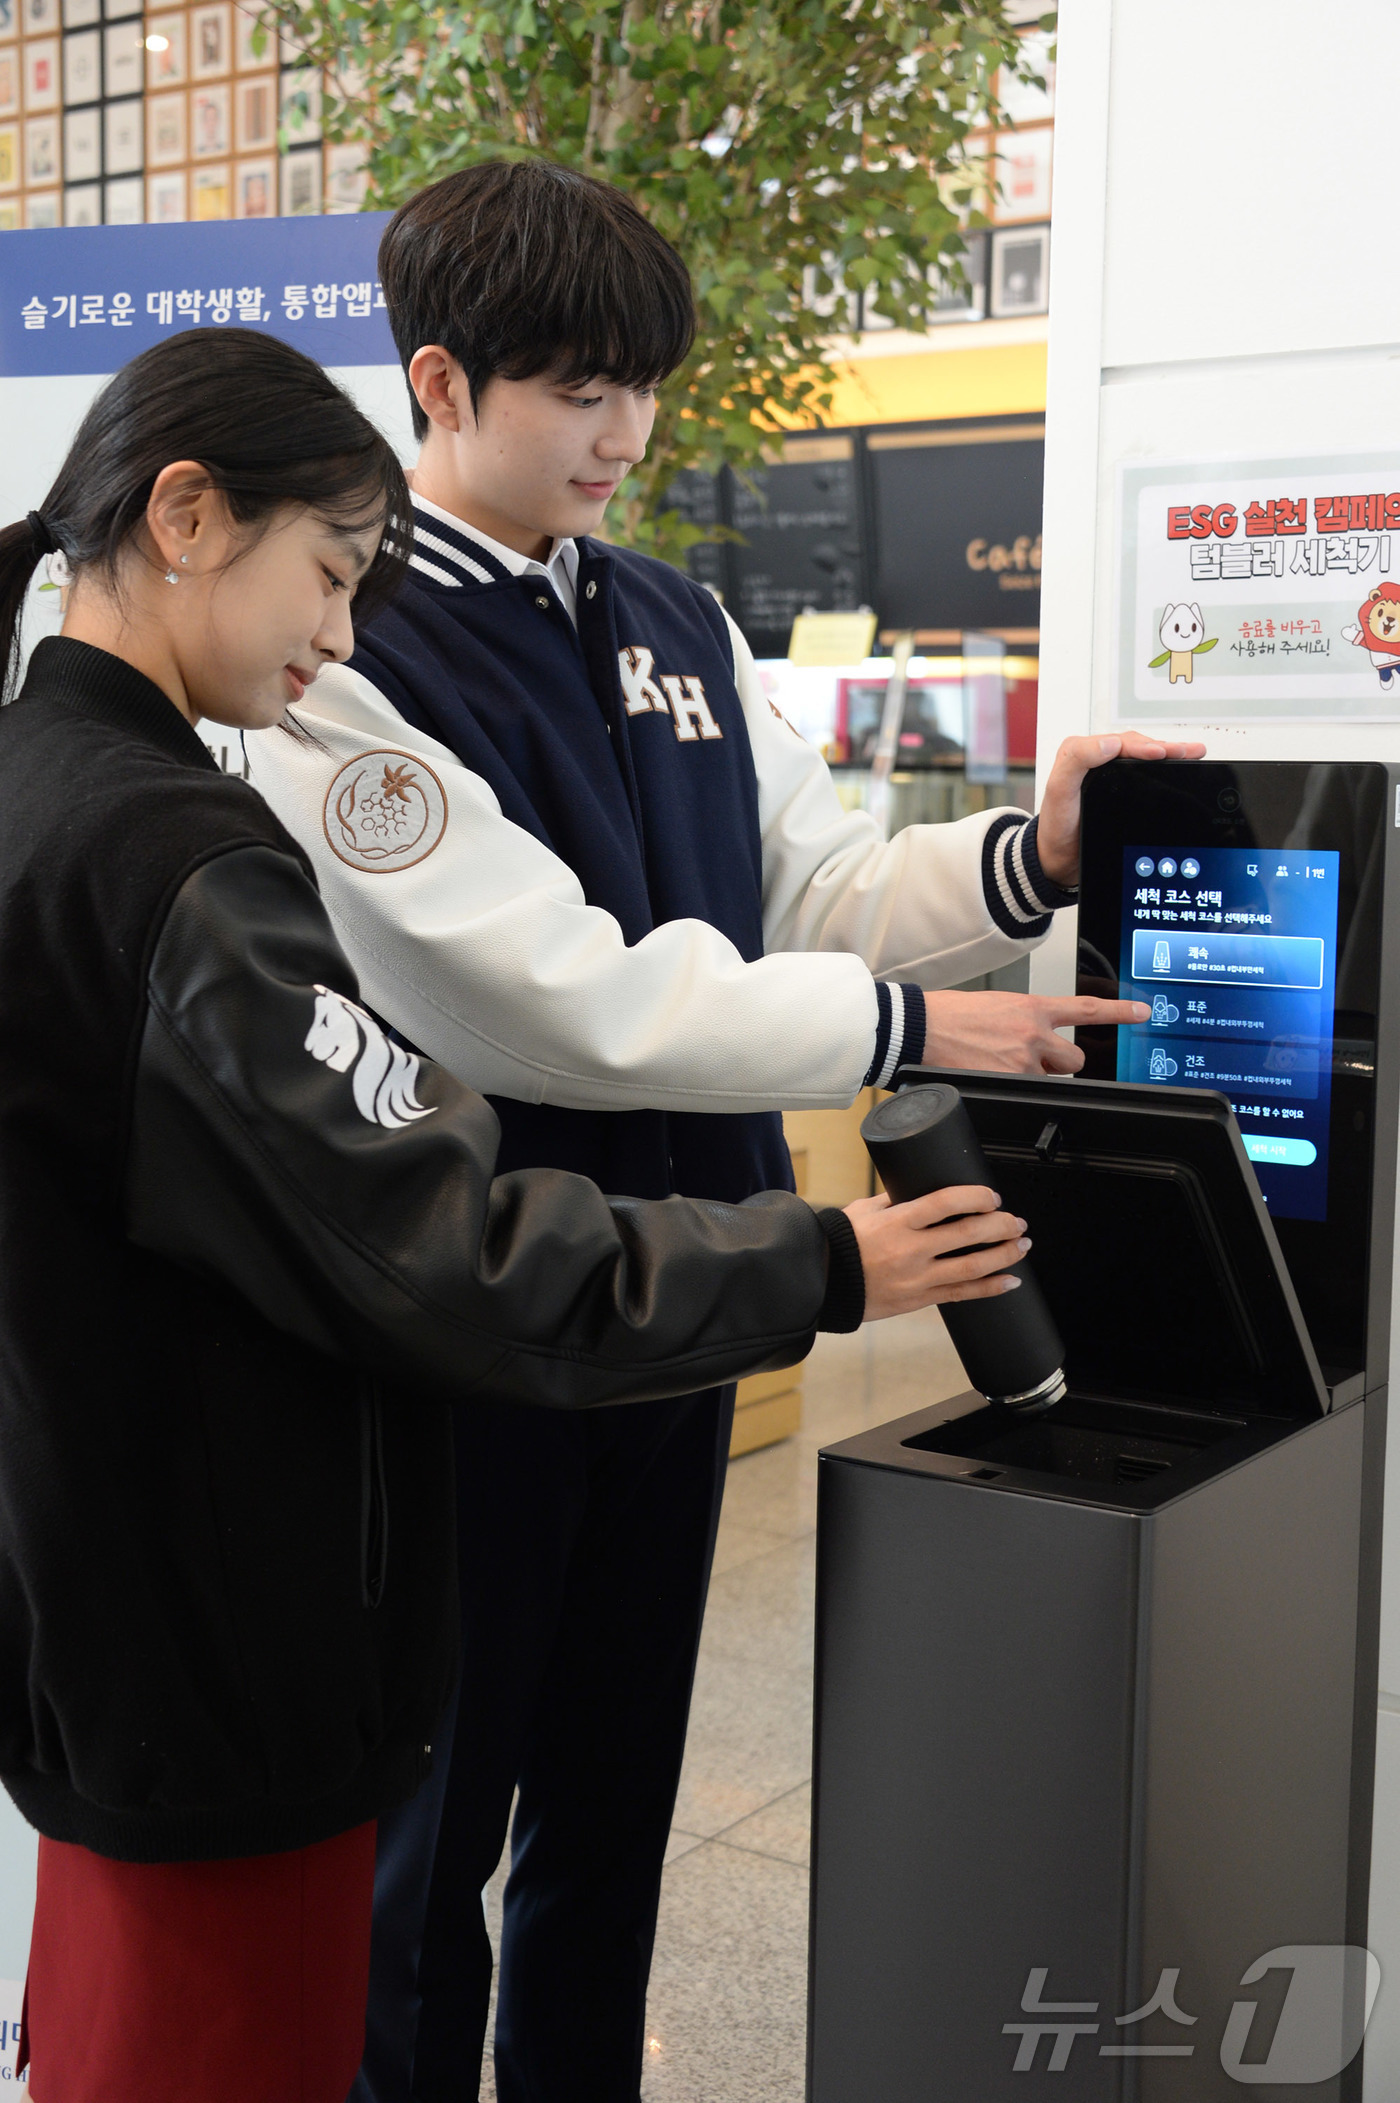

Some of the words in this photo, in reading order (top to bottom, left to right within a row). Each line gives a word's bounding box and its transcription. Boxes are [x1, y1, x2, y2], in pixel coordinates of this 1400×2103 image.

[20, 292, 136, 330] 슬기로운
[146, 287, 271, 325] 대학생활,
[1167, 503, 1238, 540] ESG
[1243, 497, 1307, 538] 실천
[1190, 540, 1285, 581] 텀블러
[1289, 535, 1391, 576] 세척기
[1238, 619, 1276, 638] 음료를
[1280, 619, 1323, 635] 비우고
[1230, 640, 1276, 657] 사용해
[1280, 639, 1331, 657] 주세요!
[617, 646, 724, 742] KH
[1134, 888, 1161, 905] 세척
[1164, 889, 1192, 904] 코스
[1195, 890, 1222, 908] 선택
[1133, 909, 1151, 920] 내게
[1151, 909, 1161, 920] 딱
[1161, 910, 1179, 921] 맞는
[1180, 910, 1197, 922] 세척
[1197, 911, 1223, 923] 코스를
[1224, 912, 1273, 925] 선택해주세요
[1186, 1000, 1208, 1014] 표준
[1185, 1054, 1206, 1068] 건조
[1200, 1072, 1216, 1080] #건조
[1238, 1105, 1261, 1117] 코스를
[1261, 1106, 1271, 1117] 할
[1271, 1107, 1281, 1118] 수
[1281, 1108, 1305, 1119] 없어요
[1251, 1144, 1268, 1155] 세척
